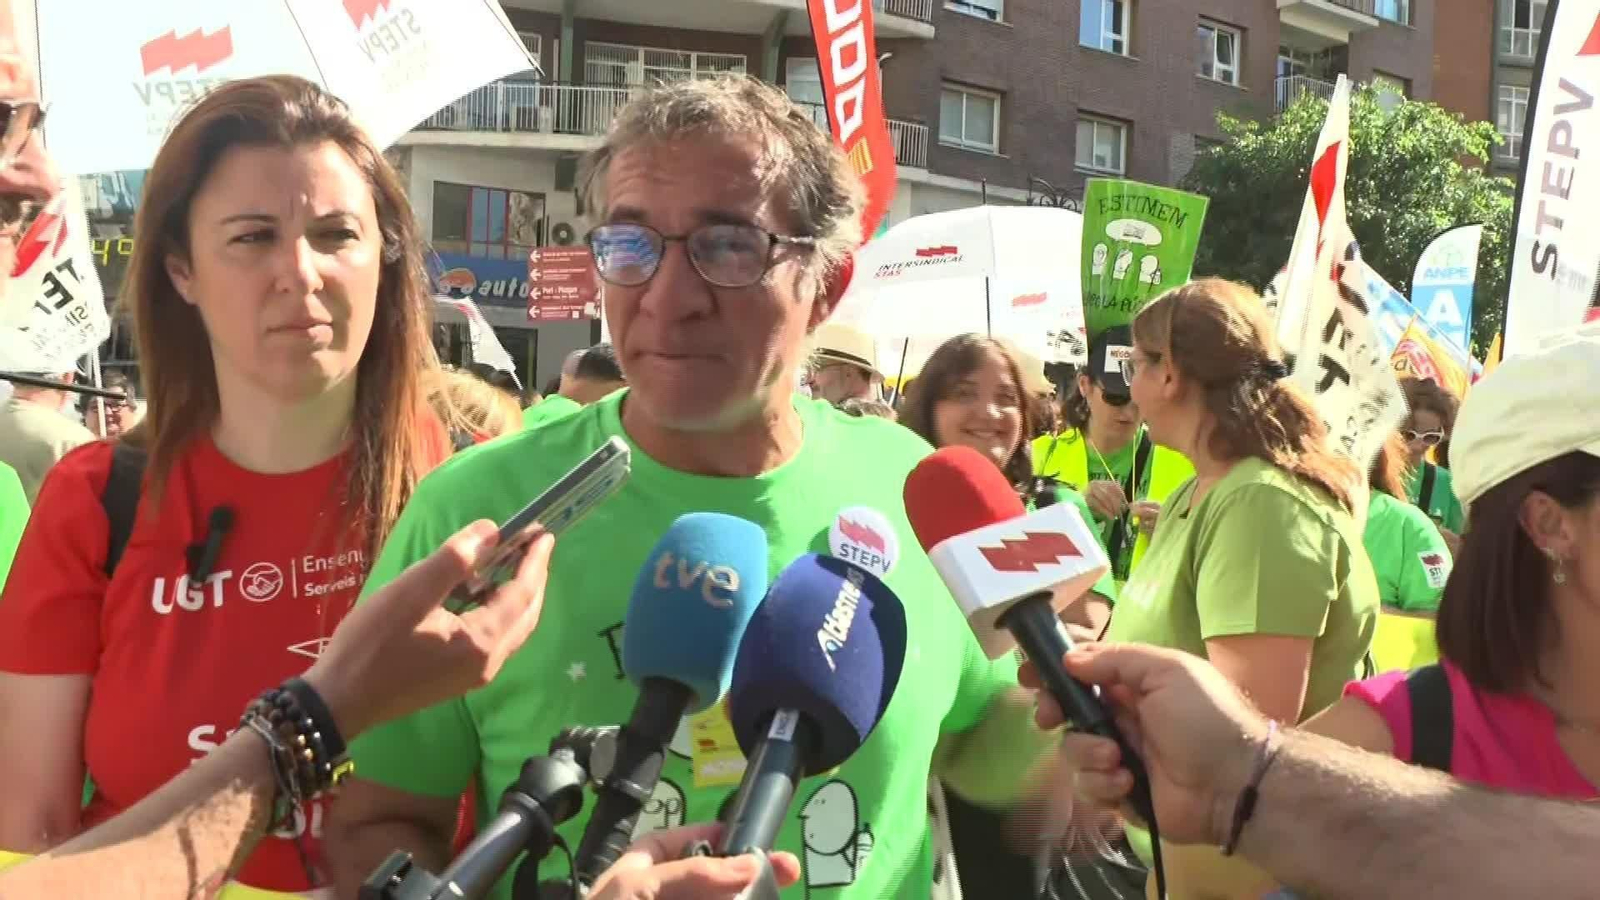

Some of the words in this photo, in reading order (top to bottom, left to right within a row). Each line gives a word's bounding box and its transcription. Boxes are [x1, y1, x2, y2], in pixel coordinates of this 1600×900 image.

[1531, 77, 1594, 281] STEPV
[1098, 193, 1188, 230] ESTIMEM
[878, 254, 964, 271] INTERSINDICAL
[1424, 266, 1470, 280] ANPE
[839, 542, 892, 574] STEPV
[152, 570, 233, 615] UGT
[654, 551, 740, 609] tve
